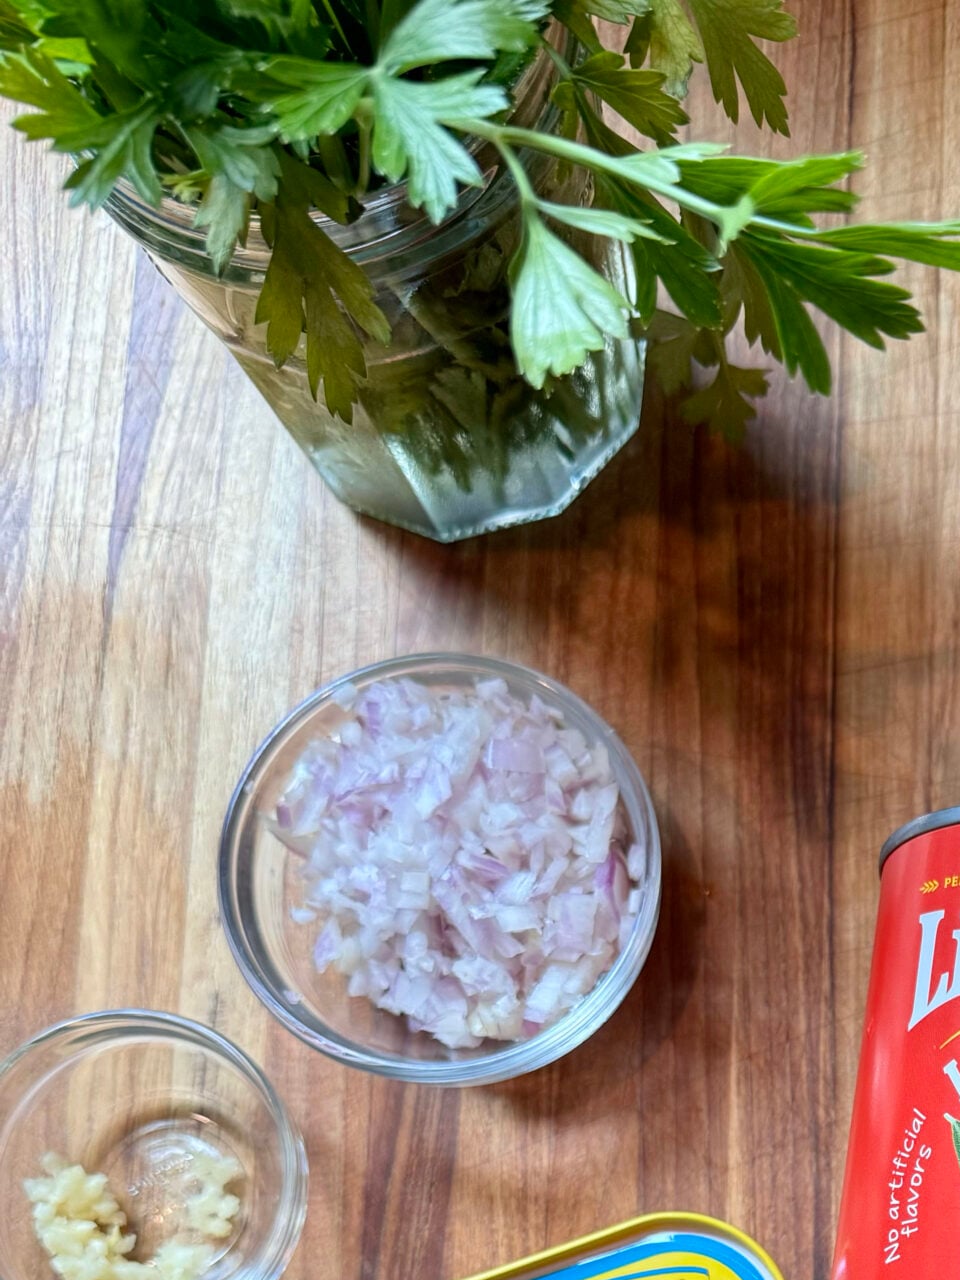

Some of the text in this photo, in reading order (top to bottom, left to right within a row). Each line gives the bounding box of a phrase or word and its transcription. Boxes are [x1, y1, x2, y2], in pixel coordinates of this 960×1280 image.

[883, 1107, 927, 1264] No artificial
[900, 1144, 932, 1237] flavors
